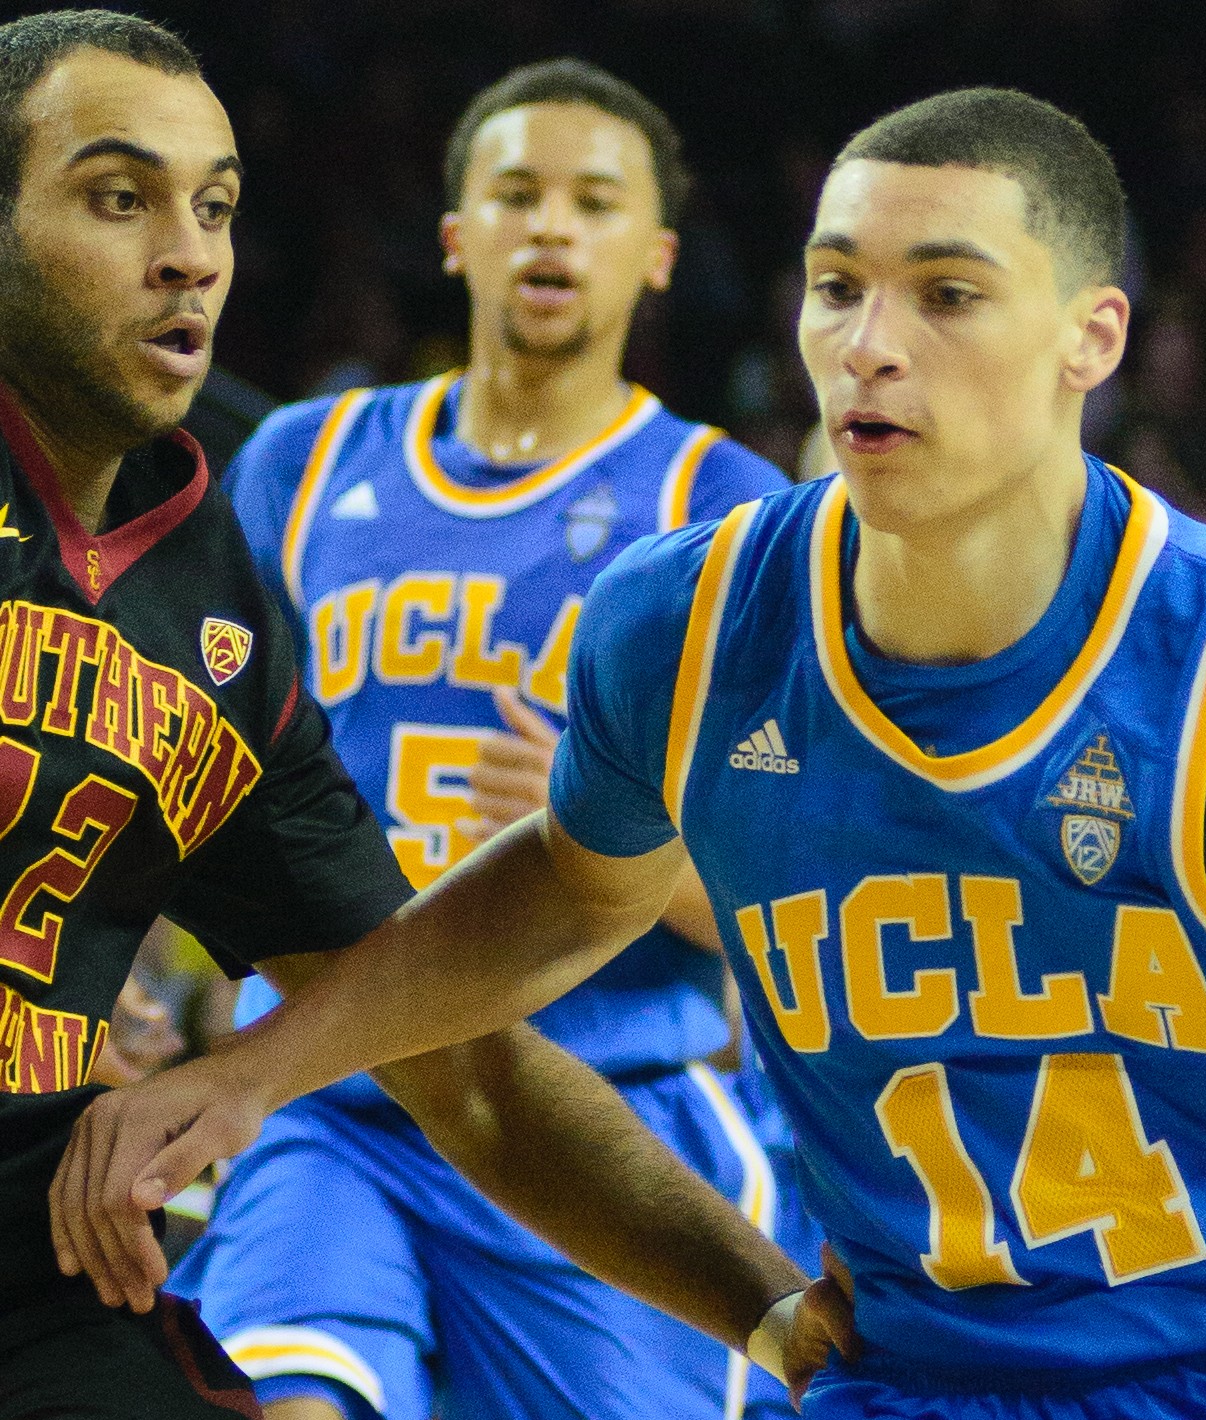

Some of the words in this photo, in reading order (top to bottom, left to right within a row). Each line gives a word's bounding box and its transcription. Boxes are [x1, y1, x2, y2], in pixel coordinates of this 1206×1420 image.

[210, 647, 233, 675] 12
[0, 600, 264, 862] UTHERN
[729, 752, 800, 774] adidas
[386, 722, 500, 894] 5
